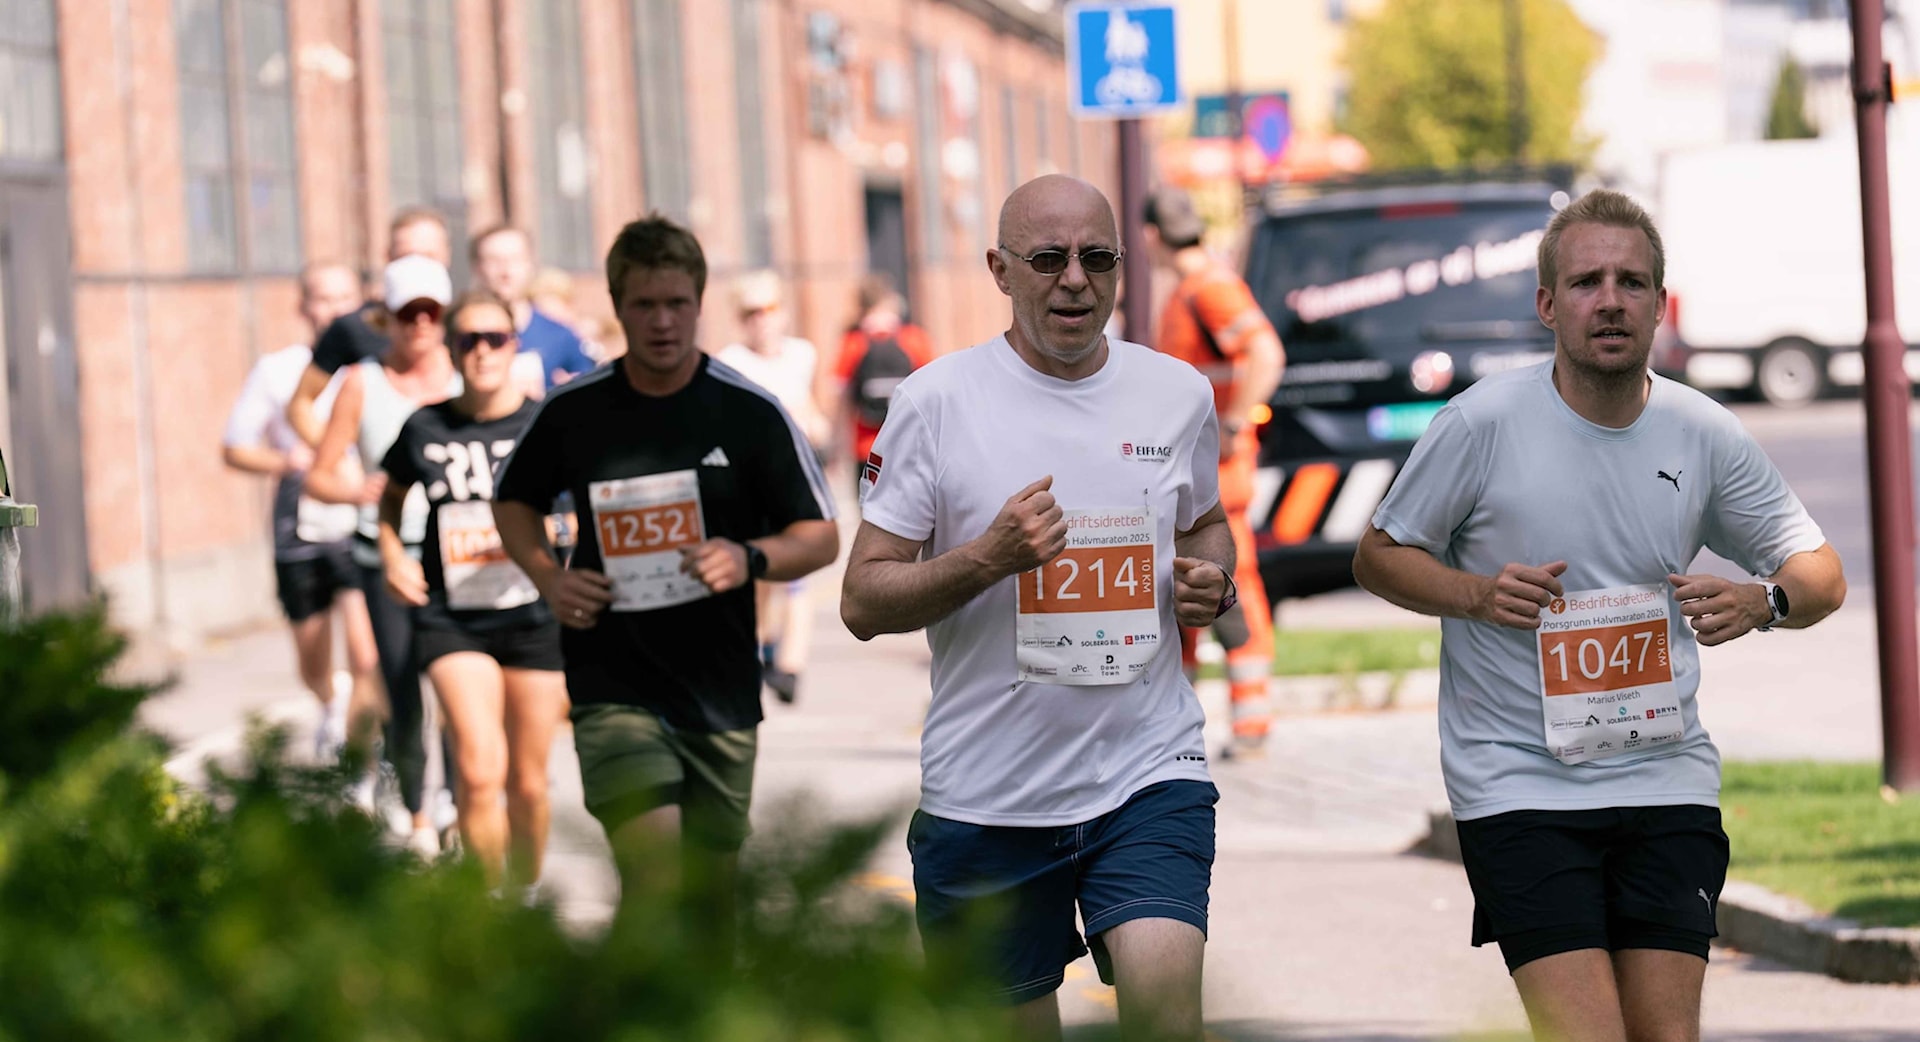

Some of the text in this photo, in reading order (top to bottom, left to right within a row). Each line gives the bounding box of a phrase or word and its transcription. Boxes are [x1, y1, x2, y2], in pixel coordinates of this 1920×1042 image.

[603, 508, 688, 549] 1252
[1072, 536, 1128, 545] Halvmaraton
[1129, 533, 1150, 543] 2025
[1027, 556, 1138, 600] 1214
[1141, 558, 1152, 593] 10 KM
[1569, 591, 1656, 611] Bedriftsidretten
[1543, 607, 1664, 631] Porsgrunn Halvmaraton 2025
[1134, 633, 1157, 641] BRYN
[1549, 631, 1653, 681] 1047
[1657, 632, 1668, 667] 10 KM
[1587, 690, 1641, 705] Marius Viseth
[1607, 716, 1631, 725] SOLBERG
[1655, 706, 1677, 714] BRYN
